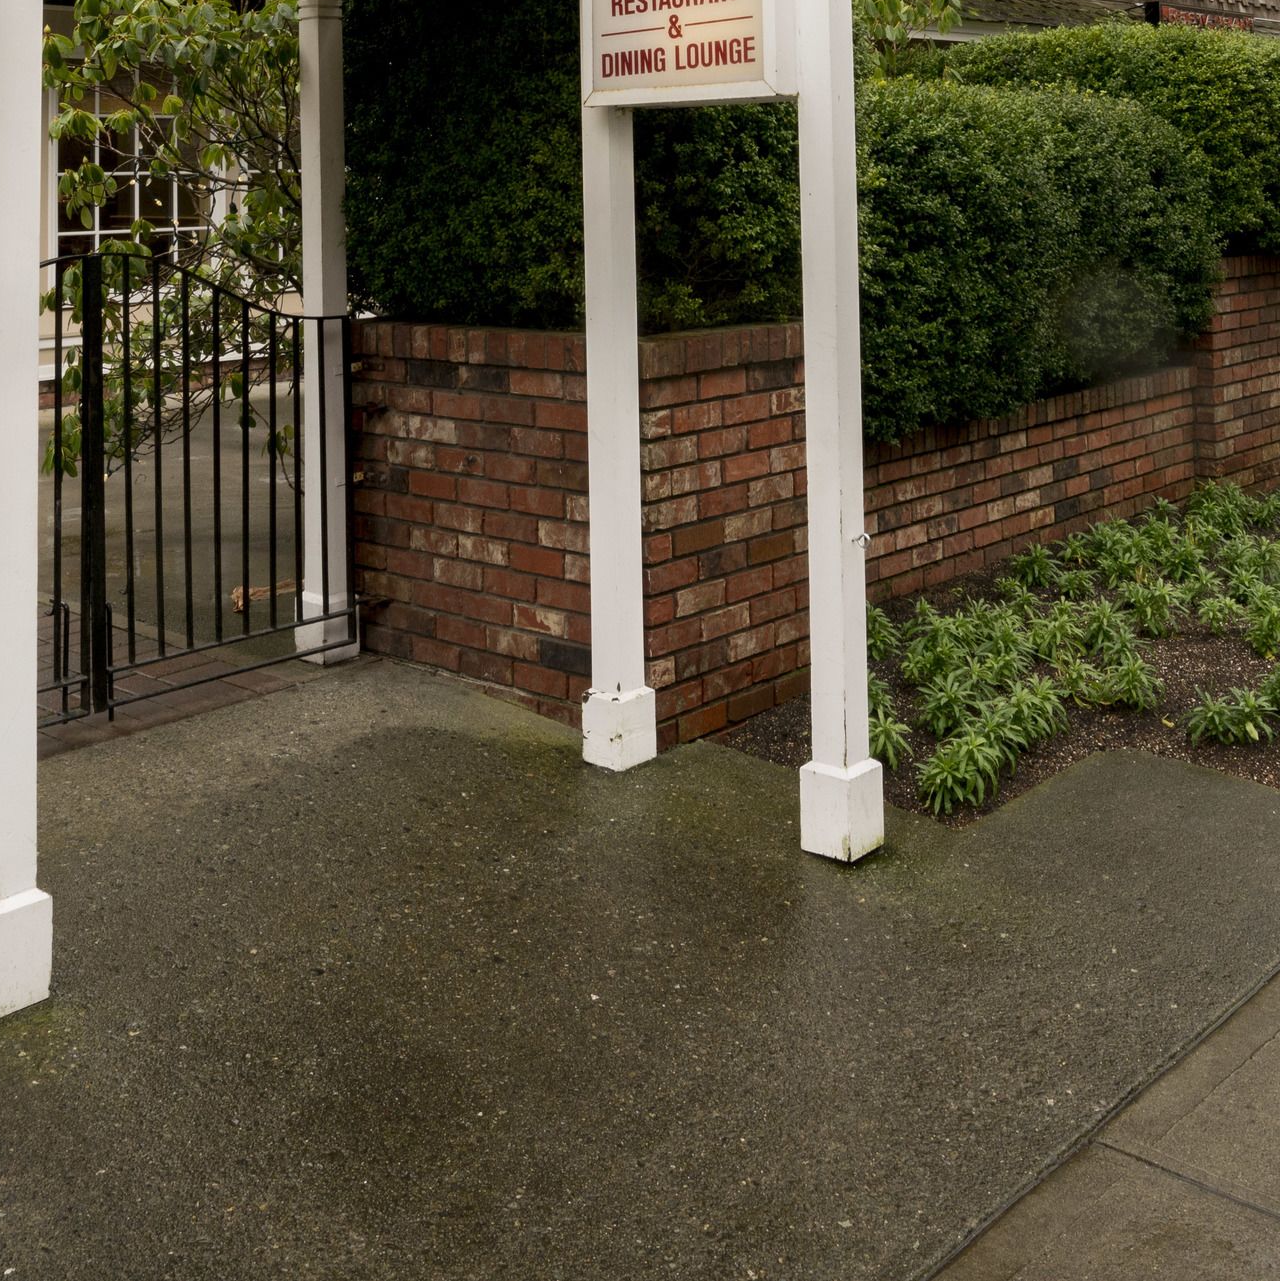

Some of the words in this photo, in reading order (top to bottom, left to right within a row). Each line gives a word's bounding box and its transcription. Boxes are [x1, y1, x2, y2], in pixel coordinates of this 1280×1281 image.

[667, 14, 683, 39] &
[601, 47, 666, 78] DINING
[675, 36, 756, 71] LOUNGE
